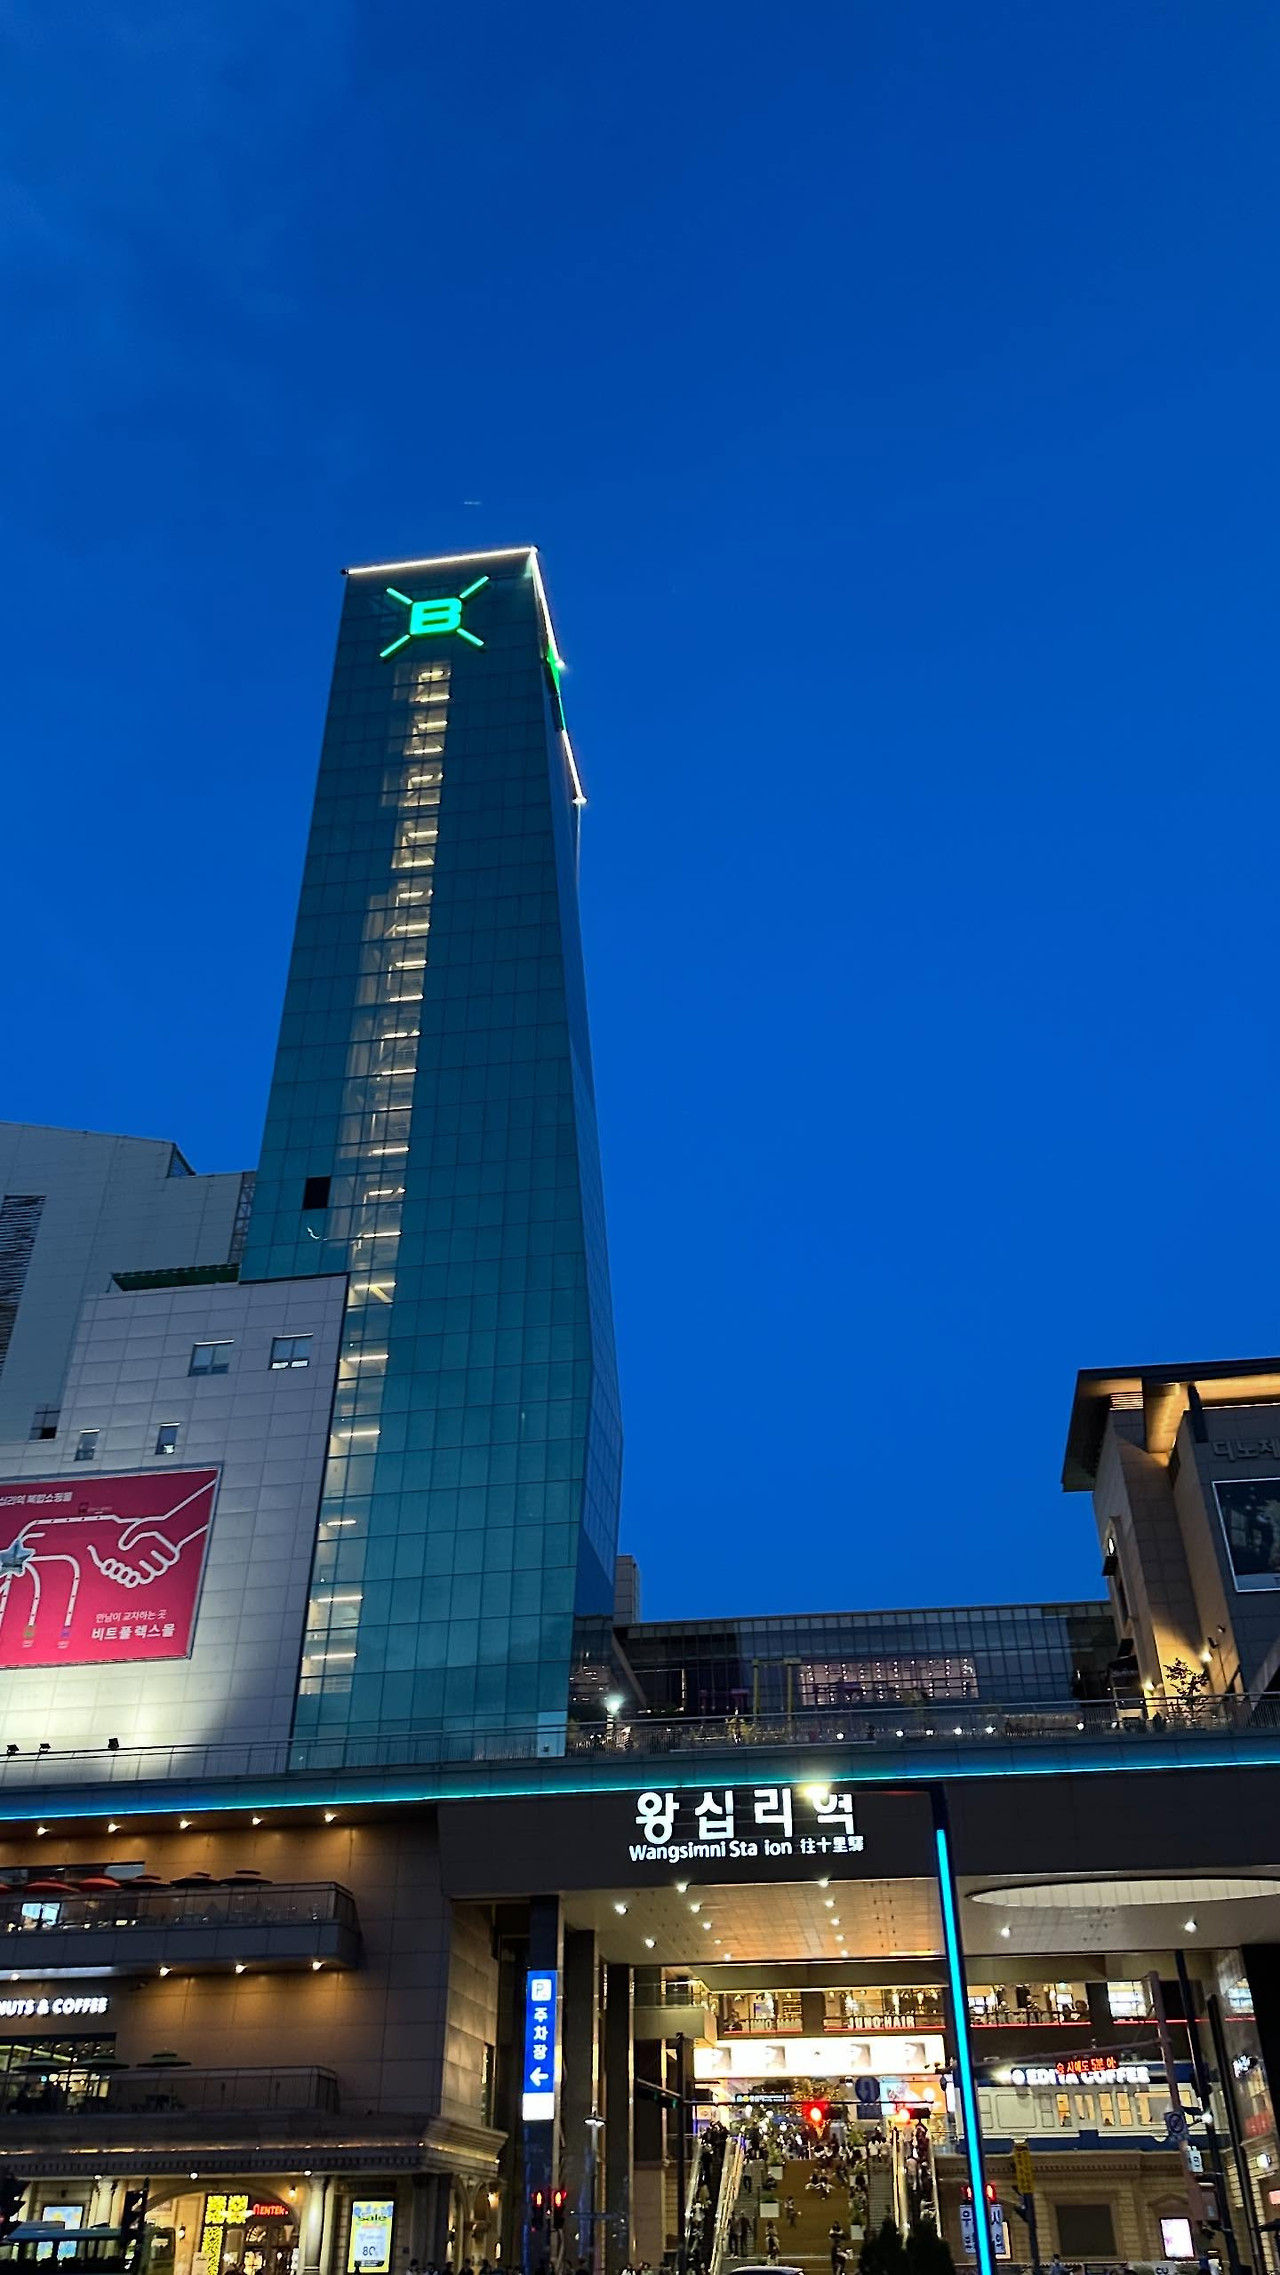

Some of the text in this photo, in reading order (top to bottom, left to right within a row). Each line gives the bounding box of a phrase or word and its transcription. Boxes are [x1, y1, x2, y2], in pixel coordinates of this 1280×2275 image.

[95, 1612, 121, 1624] 만남이
[91, 1623, 175, 1641] 비트플렉스몰
[635, 1788, 855, 1844] 왕십리역
[628, 1839, 793, 1864] Wangsimni Staion
[37, 1998, 49, 2015] &
[52, 1997, 108, 2014] COFFEE
[533, 2007, 549, 2060] 주차장
